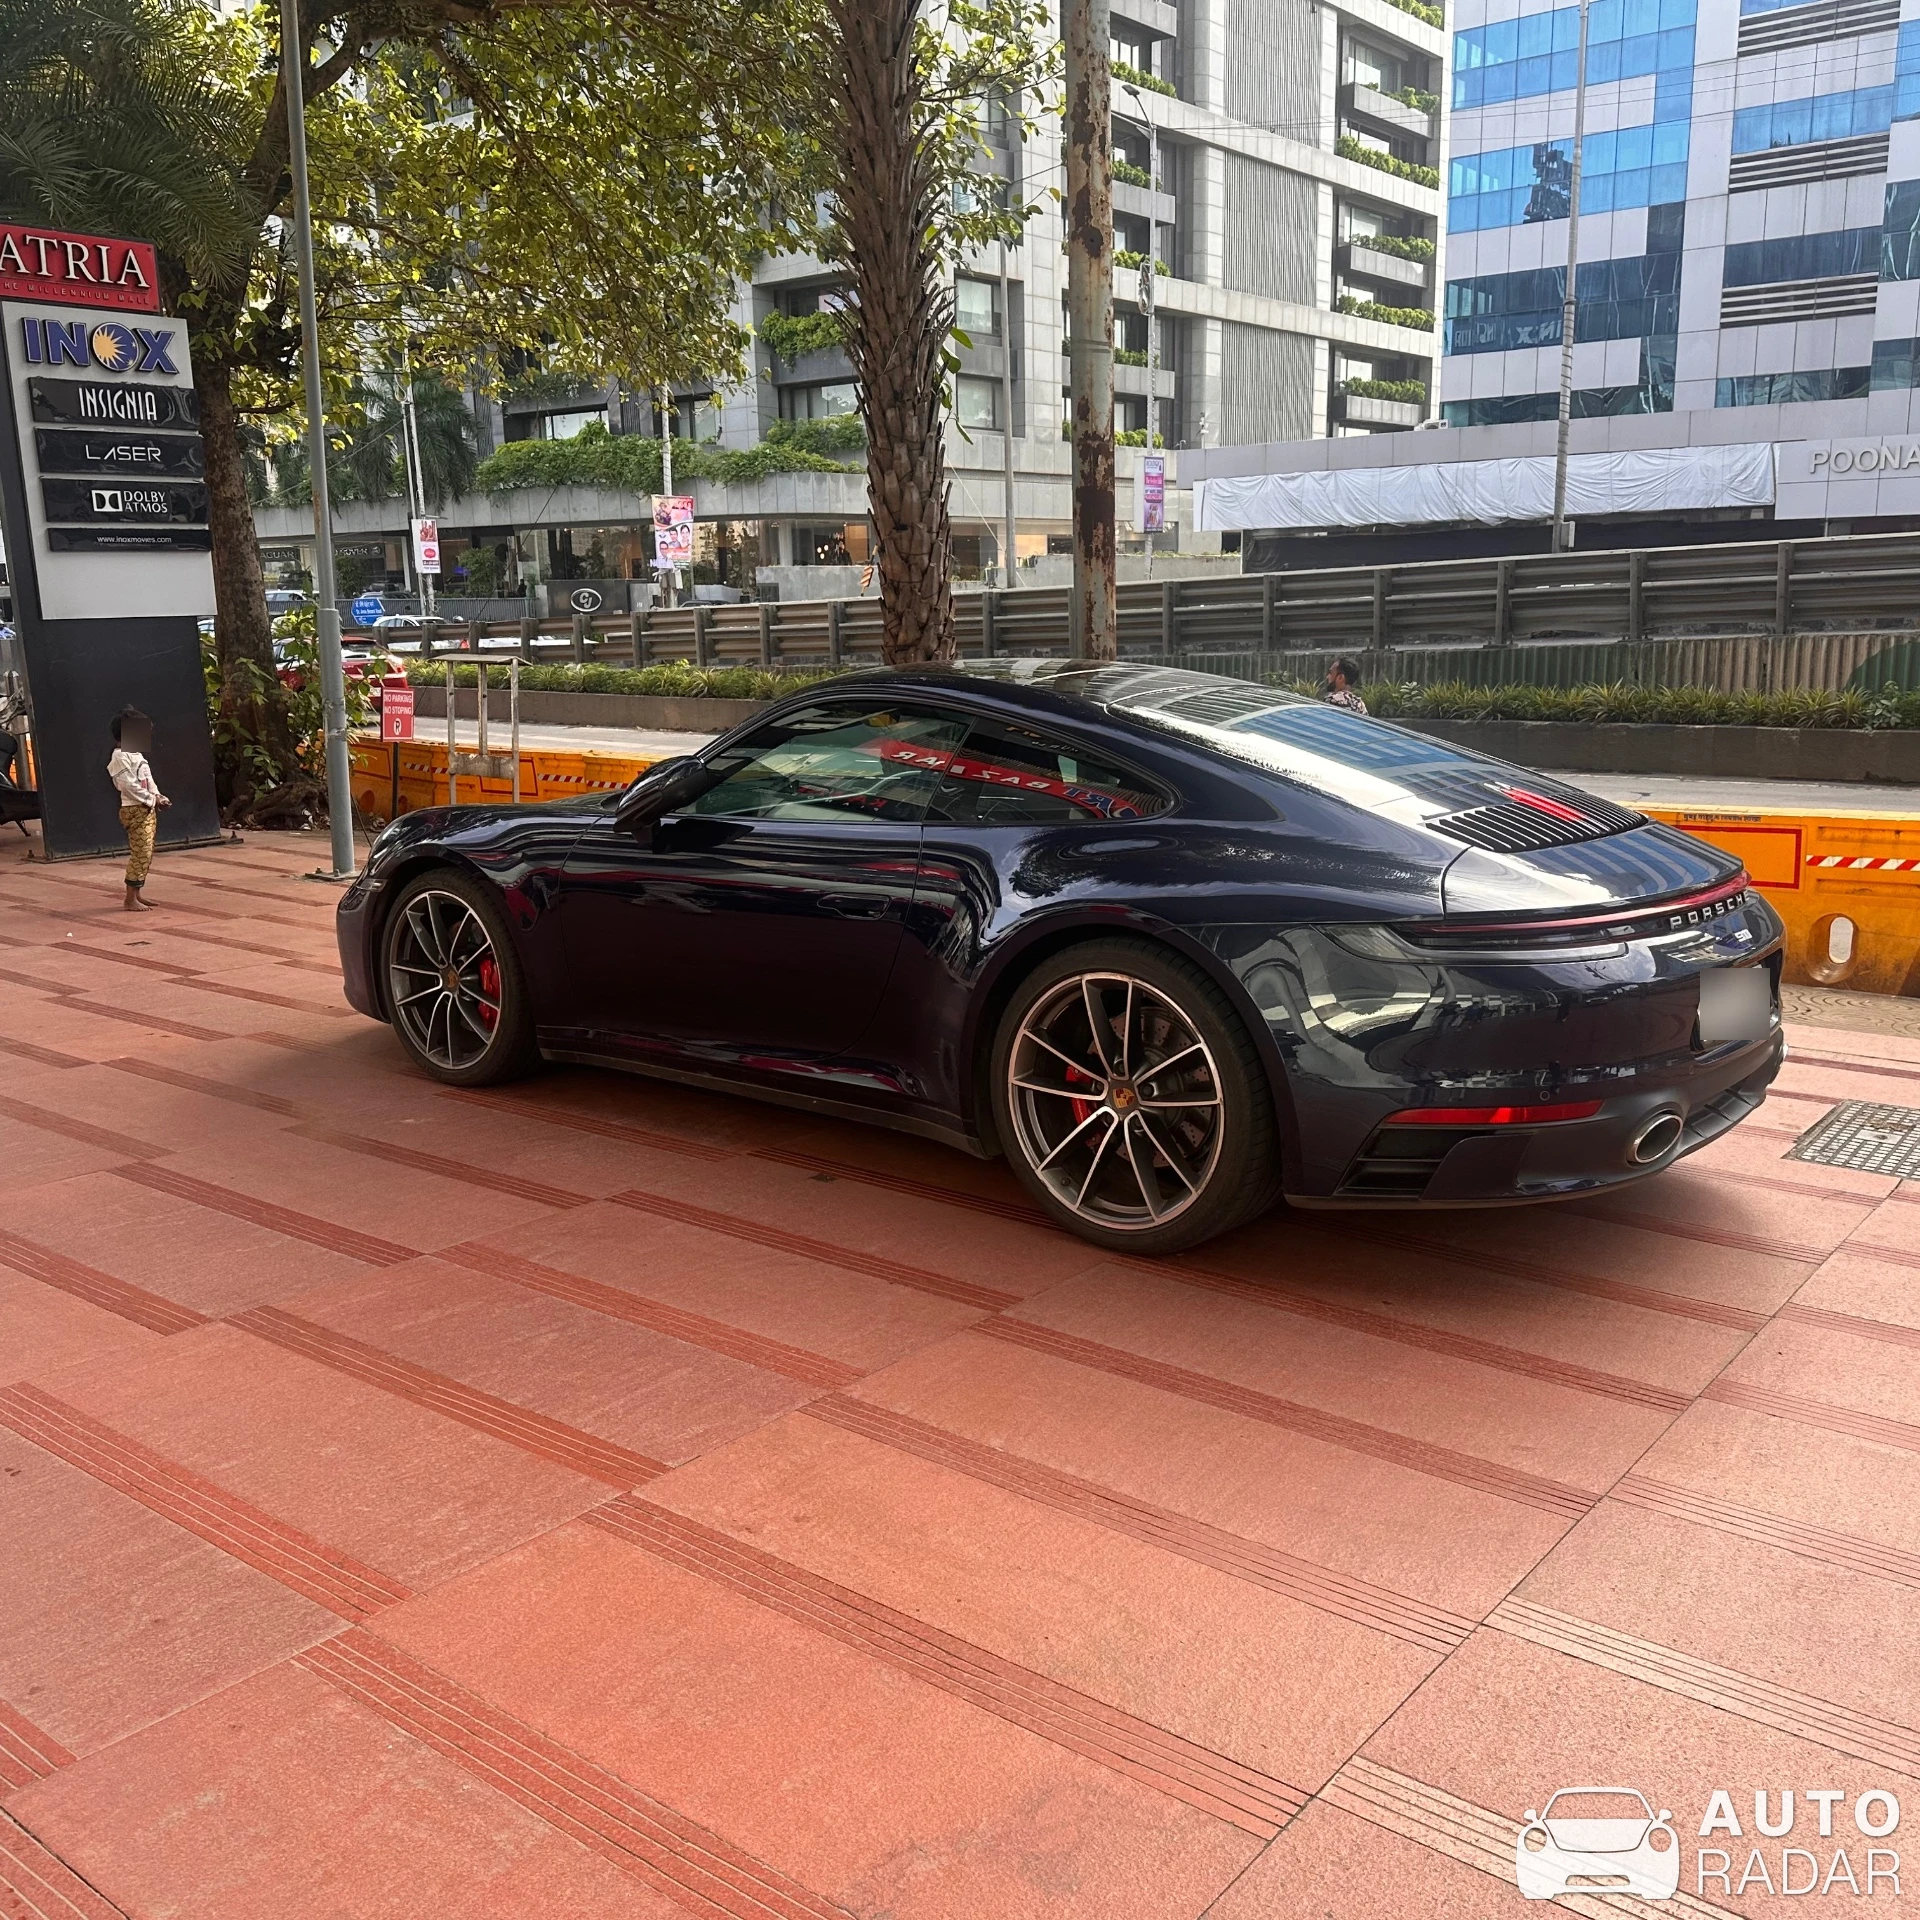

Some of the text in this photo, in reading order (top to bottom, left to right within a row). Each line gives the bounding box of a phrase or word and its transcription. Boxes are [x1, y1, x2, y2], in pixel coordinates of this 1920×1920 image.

[0, 232, 151, 288] ATRIA
[4, 281, 150, 304] HE MILLENNIUM MALL
[21, 316, 180, 374] INOX
[78, 387, 157, 420] INSIGNIA
[85, 444, 161, 462] LASER
[1809, 443, 1920, 475] POONA
[124, 490, 166, 503] DOLBY
[125, 501, 168, 513] ATMOS
[260, 551, 295, 559] AGUAR
[384, 694, 412, 704] NO PARKING
[384, 706, 412, 715] NO STOPING
[1670, 889, 1750, 930] PORSCHE
